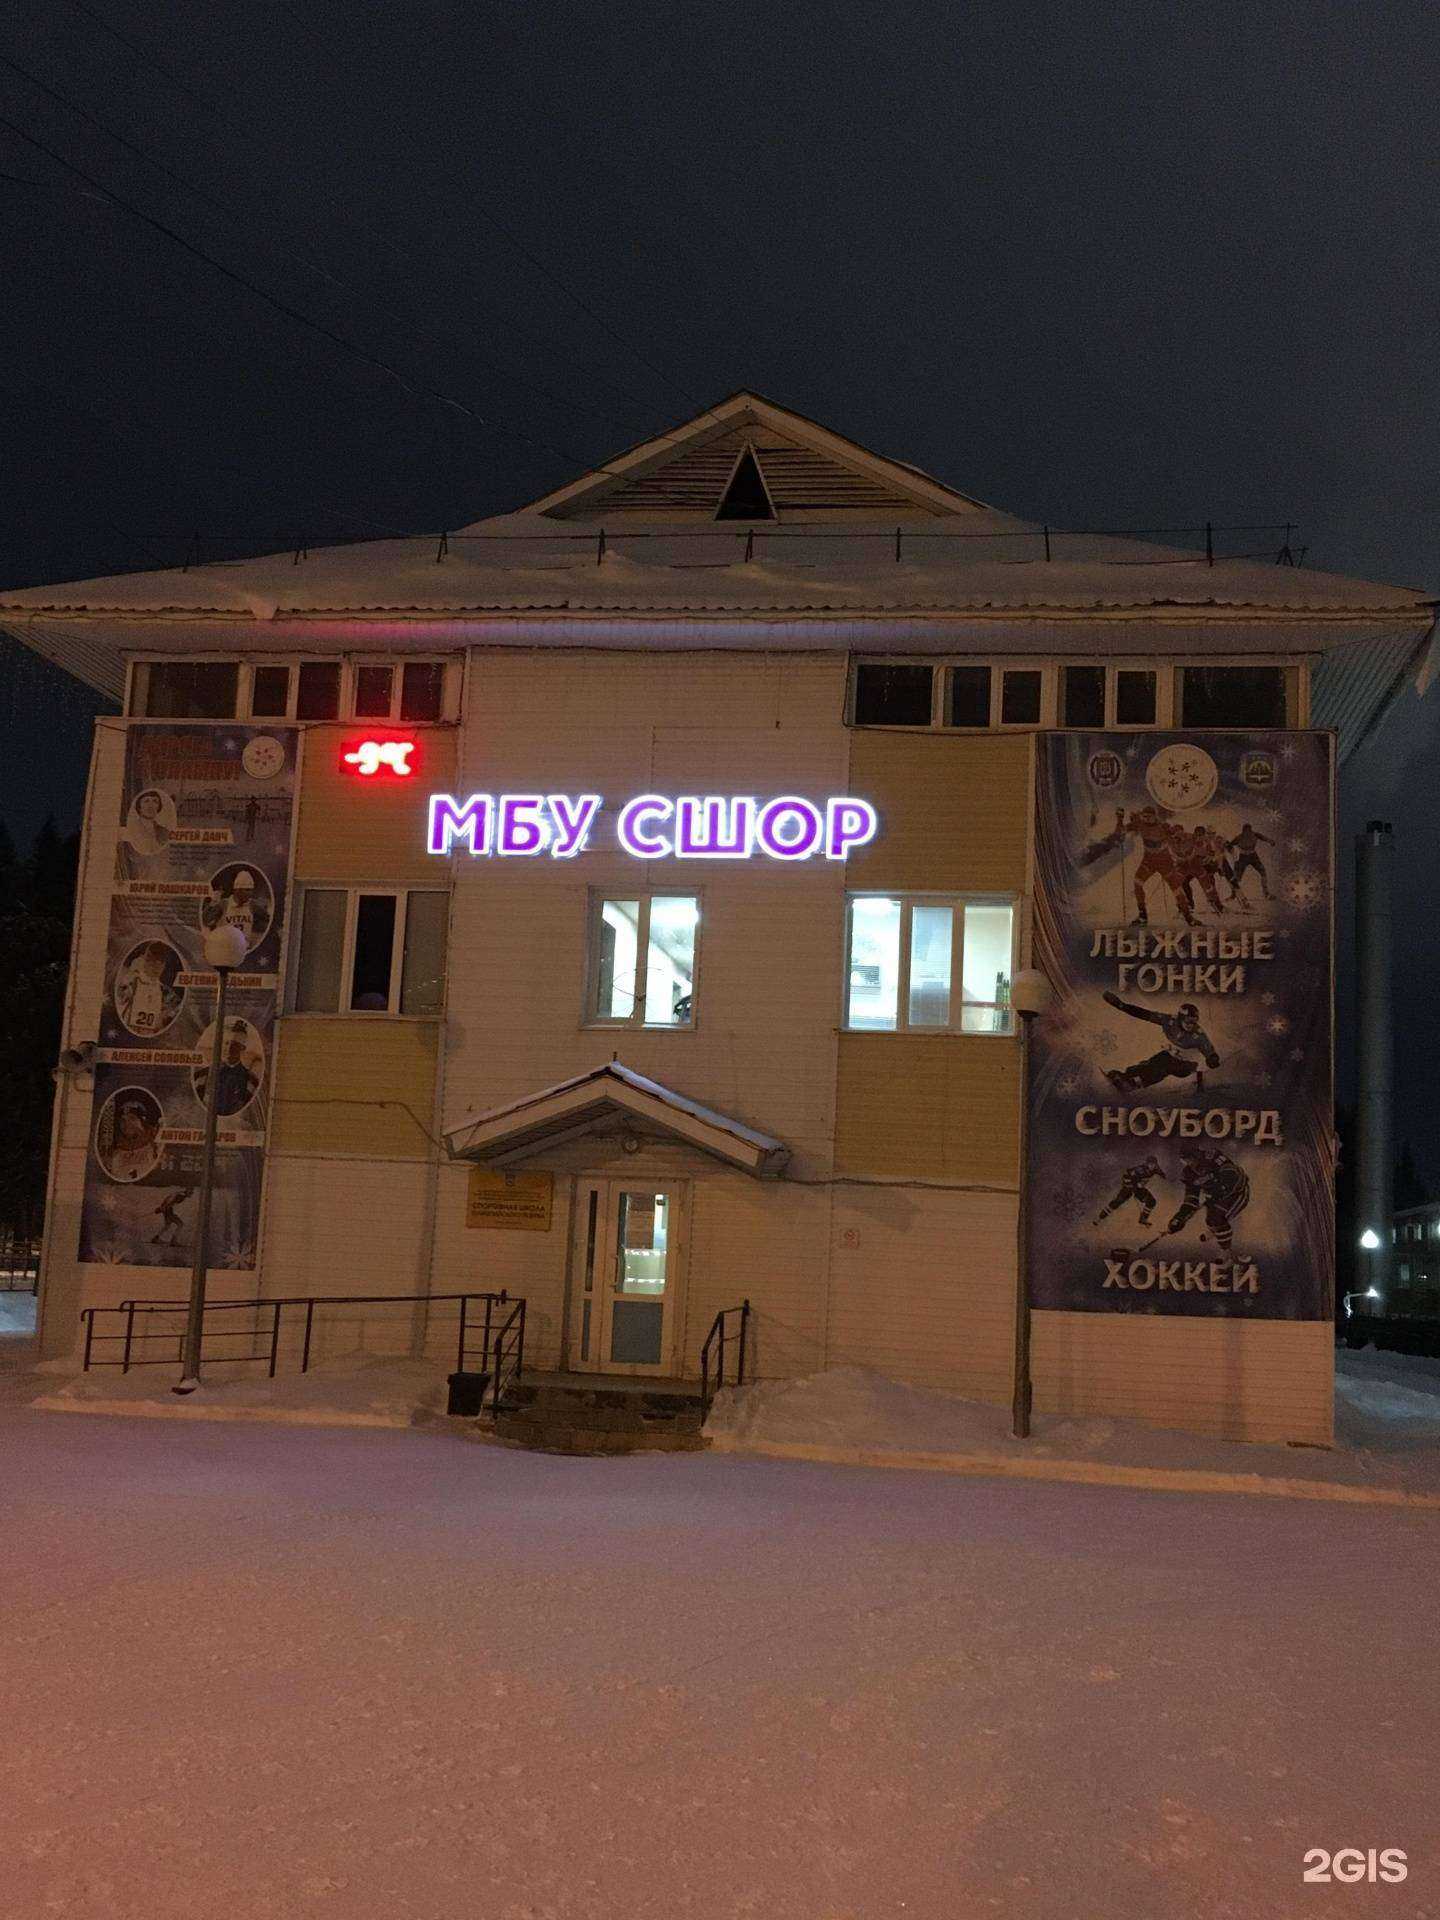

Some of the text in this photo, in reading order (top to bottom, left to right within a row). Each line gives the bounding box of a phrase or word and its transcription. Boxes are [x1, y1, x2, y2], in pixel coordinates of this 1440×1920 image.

[427, 794, 877, 860] МБУ СШОР
[1090, 929, 1275, 960] ЛЫЖНЫЕ
[1118, 964, 1247, 993] ГОНКИ
[136, 1011, 154, 1026] 20
[1075, 1105, 1282, 1146] СНОУБОРД
[1102, 1254, 1260, 1293] ХОККЕЙ
